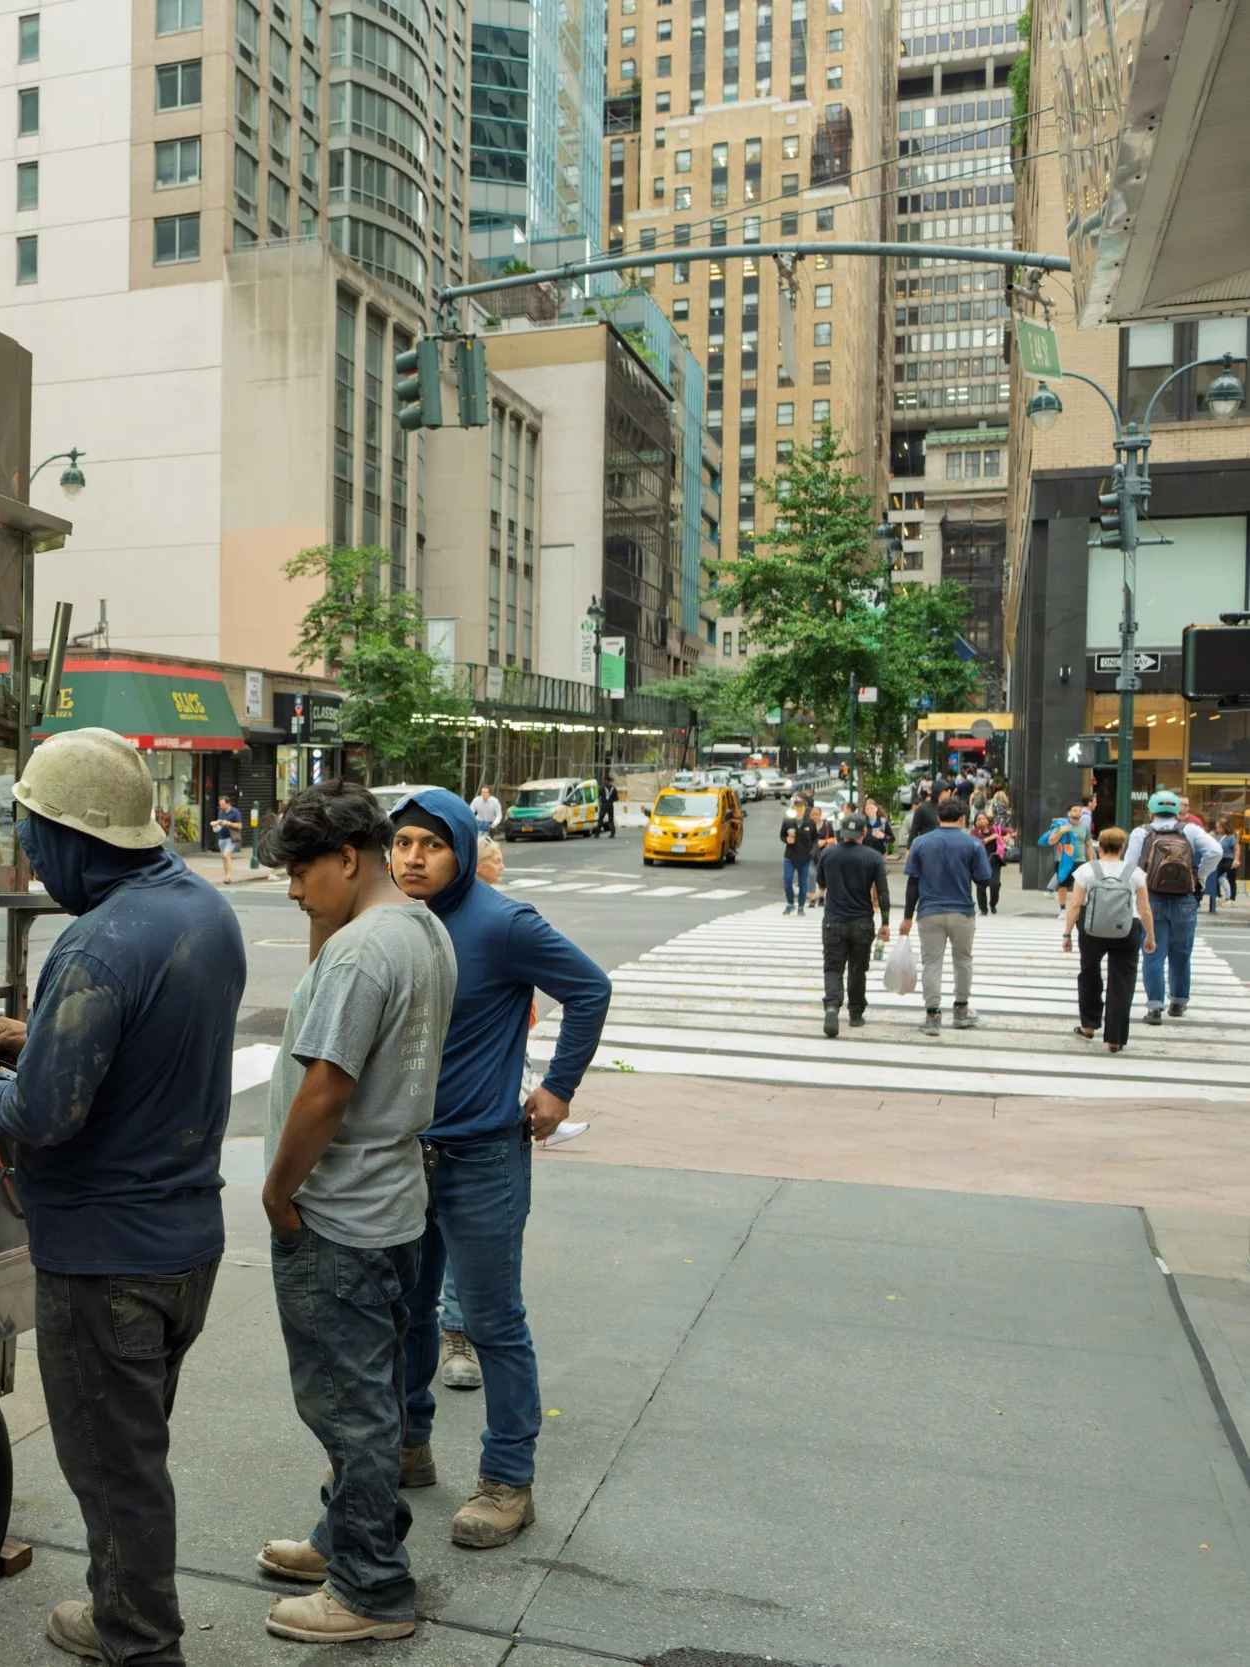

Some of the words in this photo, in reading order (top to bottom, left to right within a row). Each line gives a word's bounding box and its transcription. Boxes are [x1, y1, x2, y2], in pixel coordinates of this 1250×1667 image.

[171, 691, 205, 714] SLICE
[1131, 791, 1149, 800] AVA
[403, 1022, 431, 1038] EMPA
